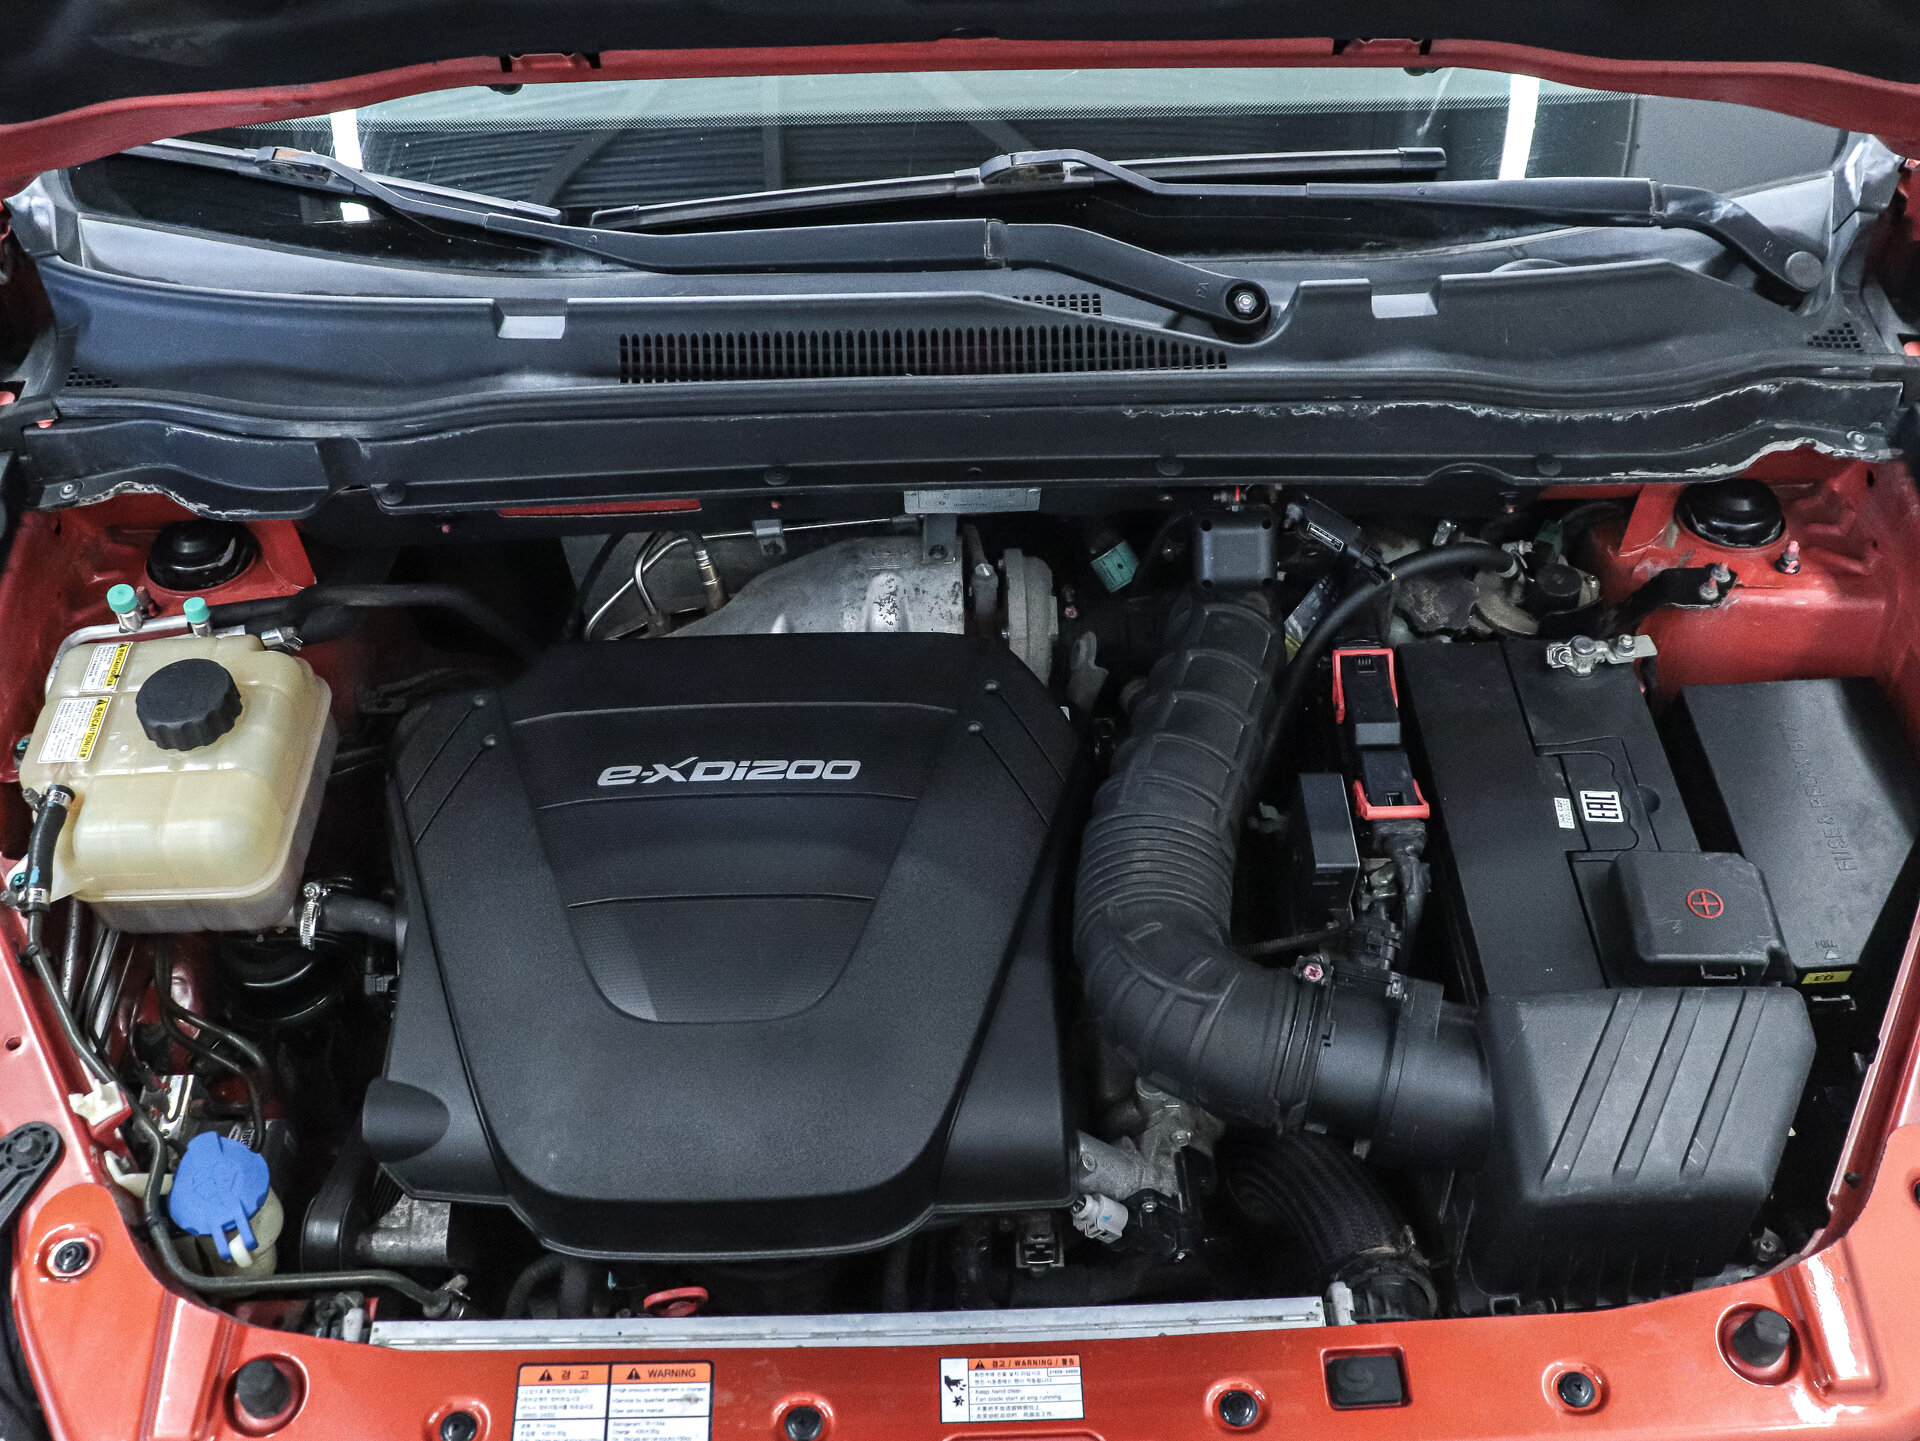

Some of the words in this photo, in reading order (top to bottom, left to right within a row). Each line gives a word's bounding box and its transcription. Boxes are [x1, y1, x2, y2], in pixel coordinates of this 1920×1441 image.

[597, 756, 862, 786] e-XDi200
[1584, 793, 1620, 819] EAC
[1822, 827, 1858, 872] FUSE
[1813, 974, 1835, 982] ED
[1014, 1358, 1053, 1367] WARNING
[648, 1368, 697, 1378] WARNING
